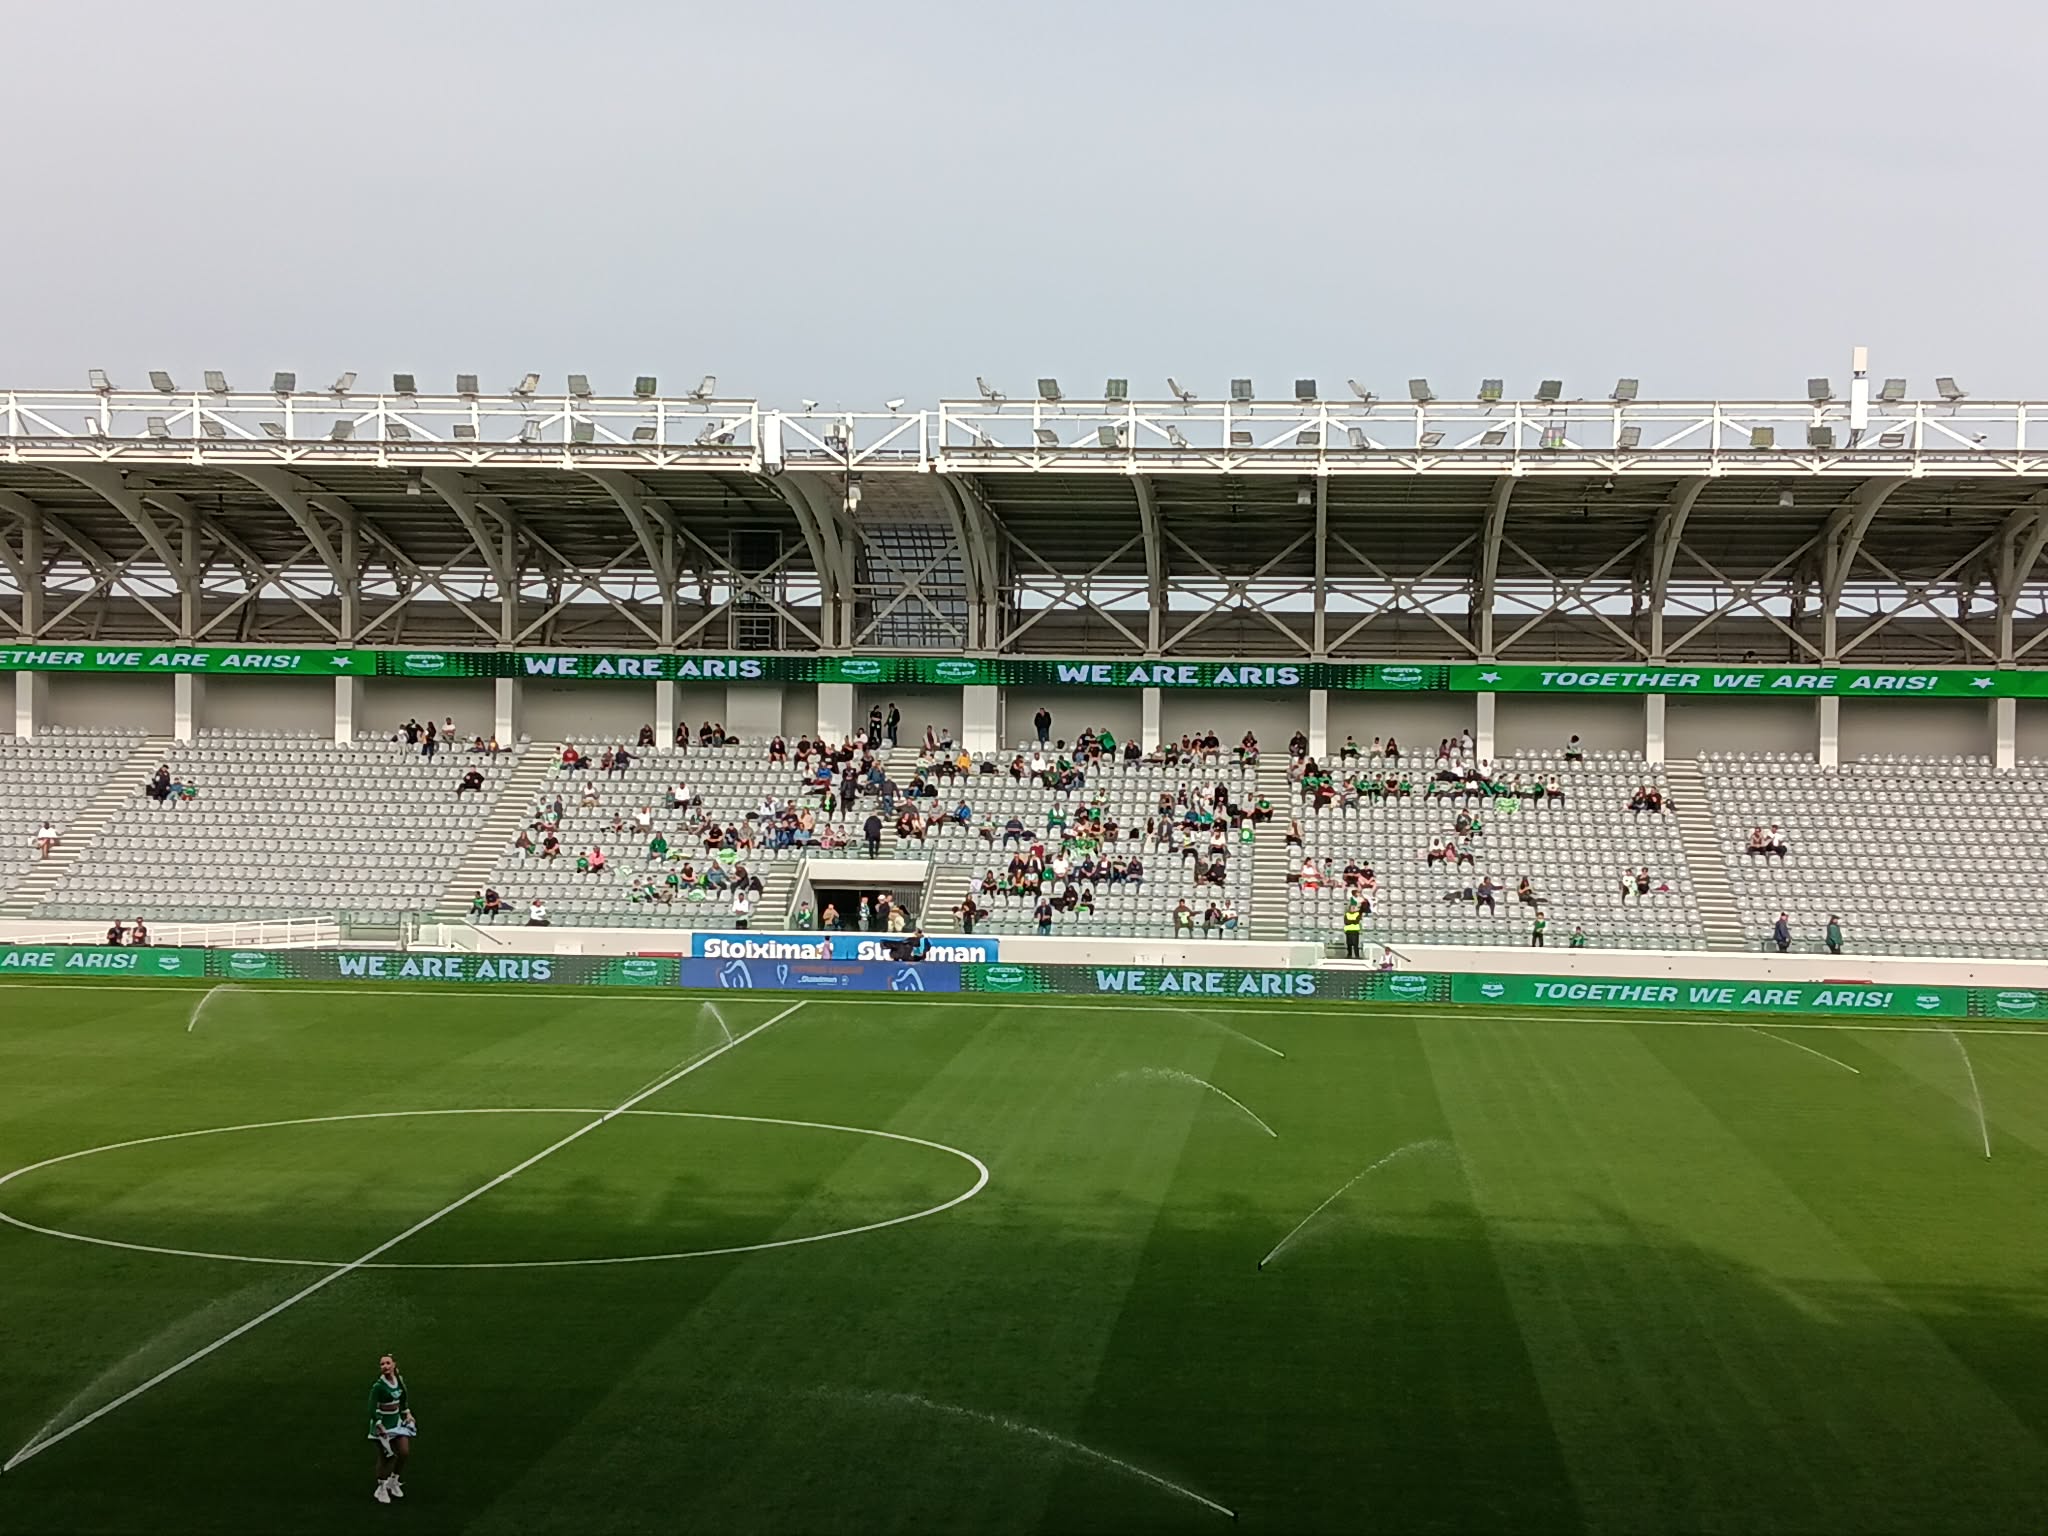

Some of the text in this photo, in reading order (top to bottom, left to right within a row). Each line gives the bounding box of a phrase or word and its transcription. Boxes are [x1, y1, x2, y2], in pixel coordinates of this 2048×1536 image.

[97, 653, 141, 665] WE
[149, 654, 209, 666] ARE
[222, 655, 301, 668] ARIS!
[524, 657, 761, 679] WE ARE ARIS
[1057, 665, 1300, 687] WE ARE ARIS
[1541, 672, 1940, 691] TOGETHER WE ARE ARIS!
[1, 952, 137, 969] ARE ARIS!
[338, 956, 552, 980] WE ARE ARIS
[1096, 970, 1316, 996] WE ARE ARIS
[1534, 982, 1893, 1008] TOGETHER WE ARE ARIS!
